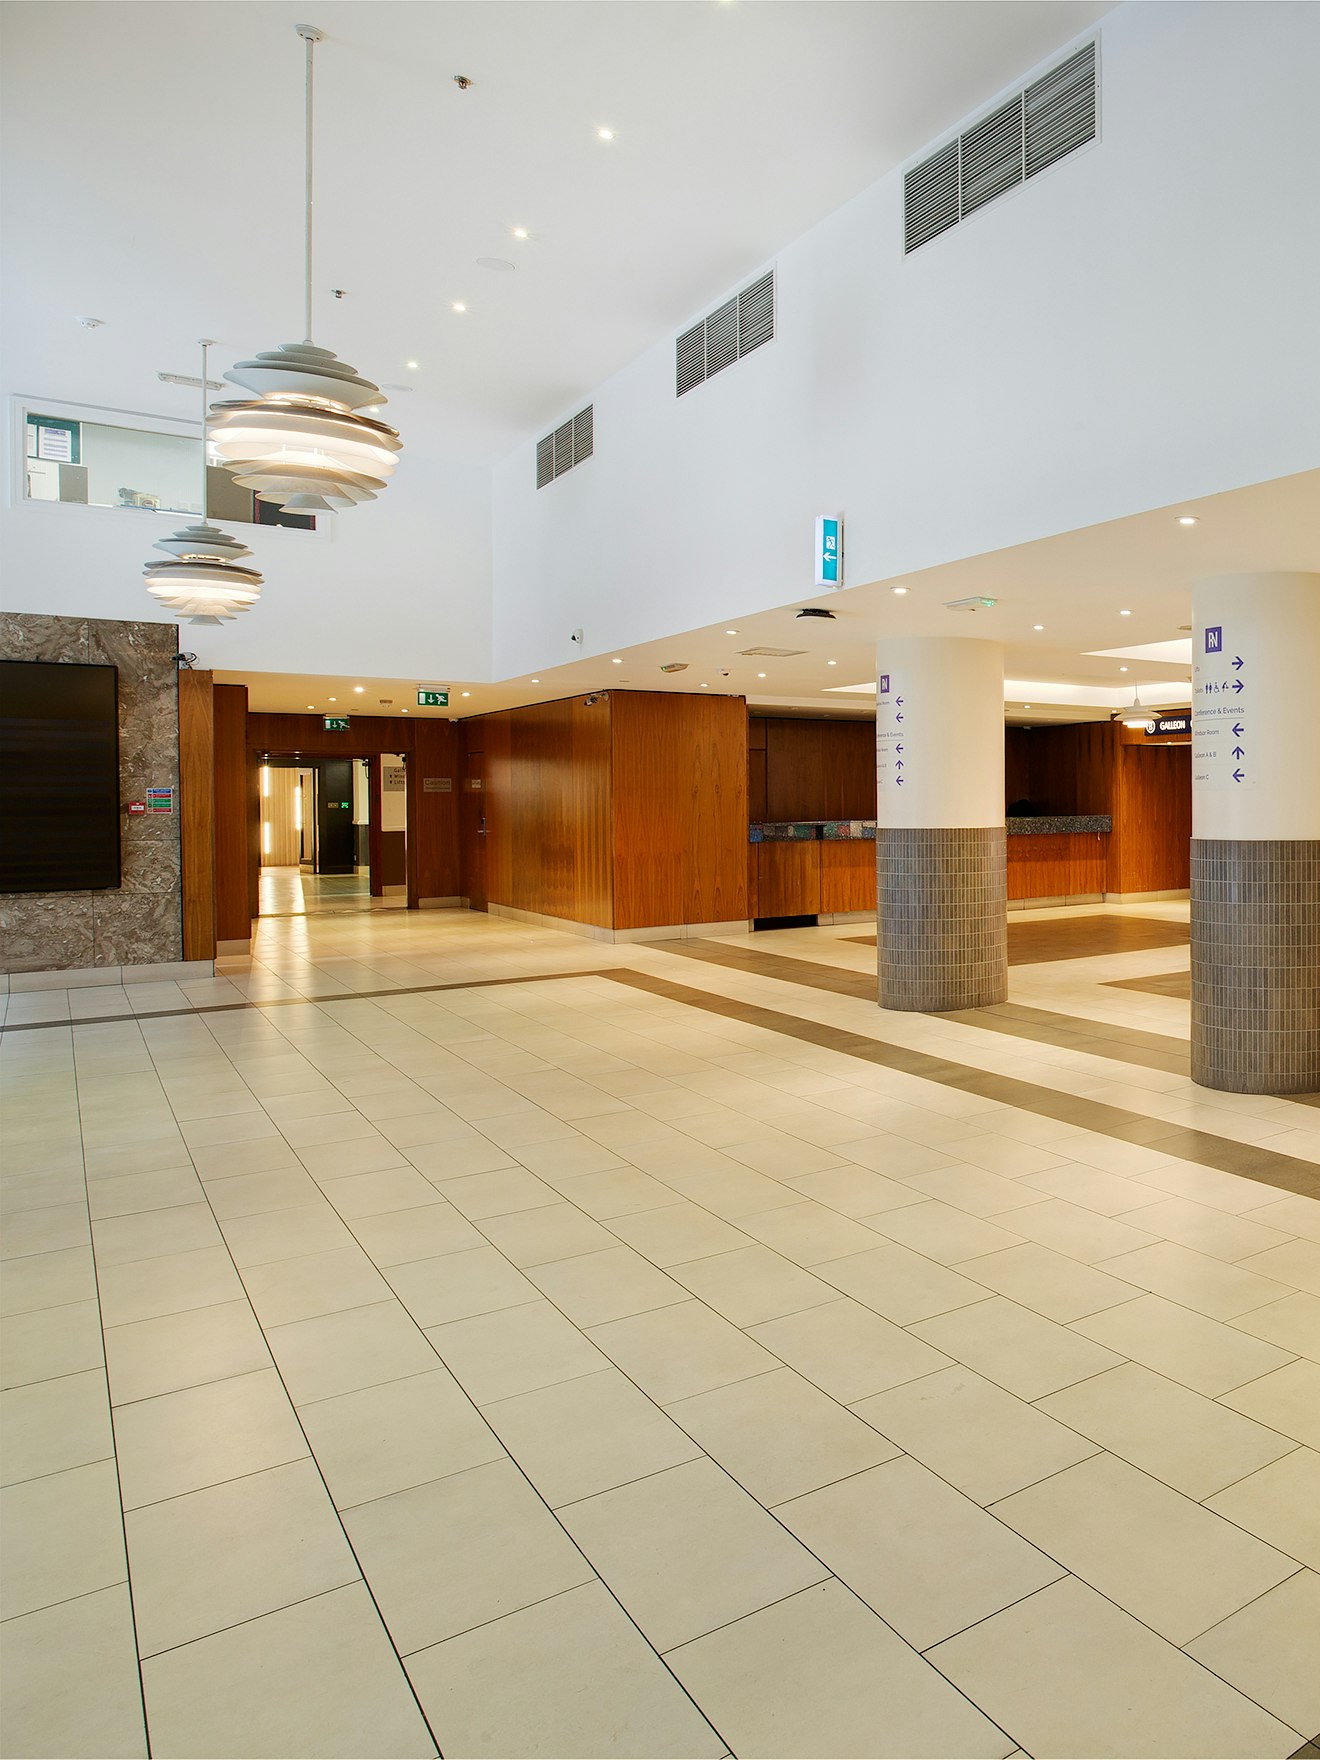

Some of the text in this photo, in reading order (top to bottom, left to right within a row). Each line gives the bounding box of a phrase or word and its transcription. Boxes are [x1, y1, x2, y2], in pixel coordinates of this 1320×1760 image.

[1194, 706, 1245, 717] nference & Events
[1159, 719, 1186, 731] GALLEON
